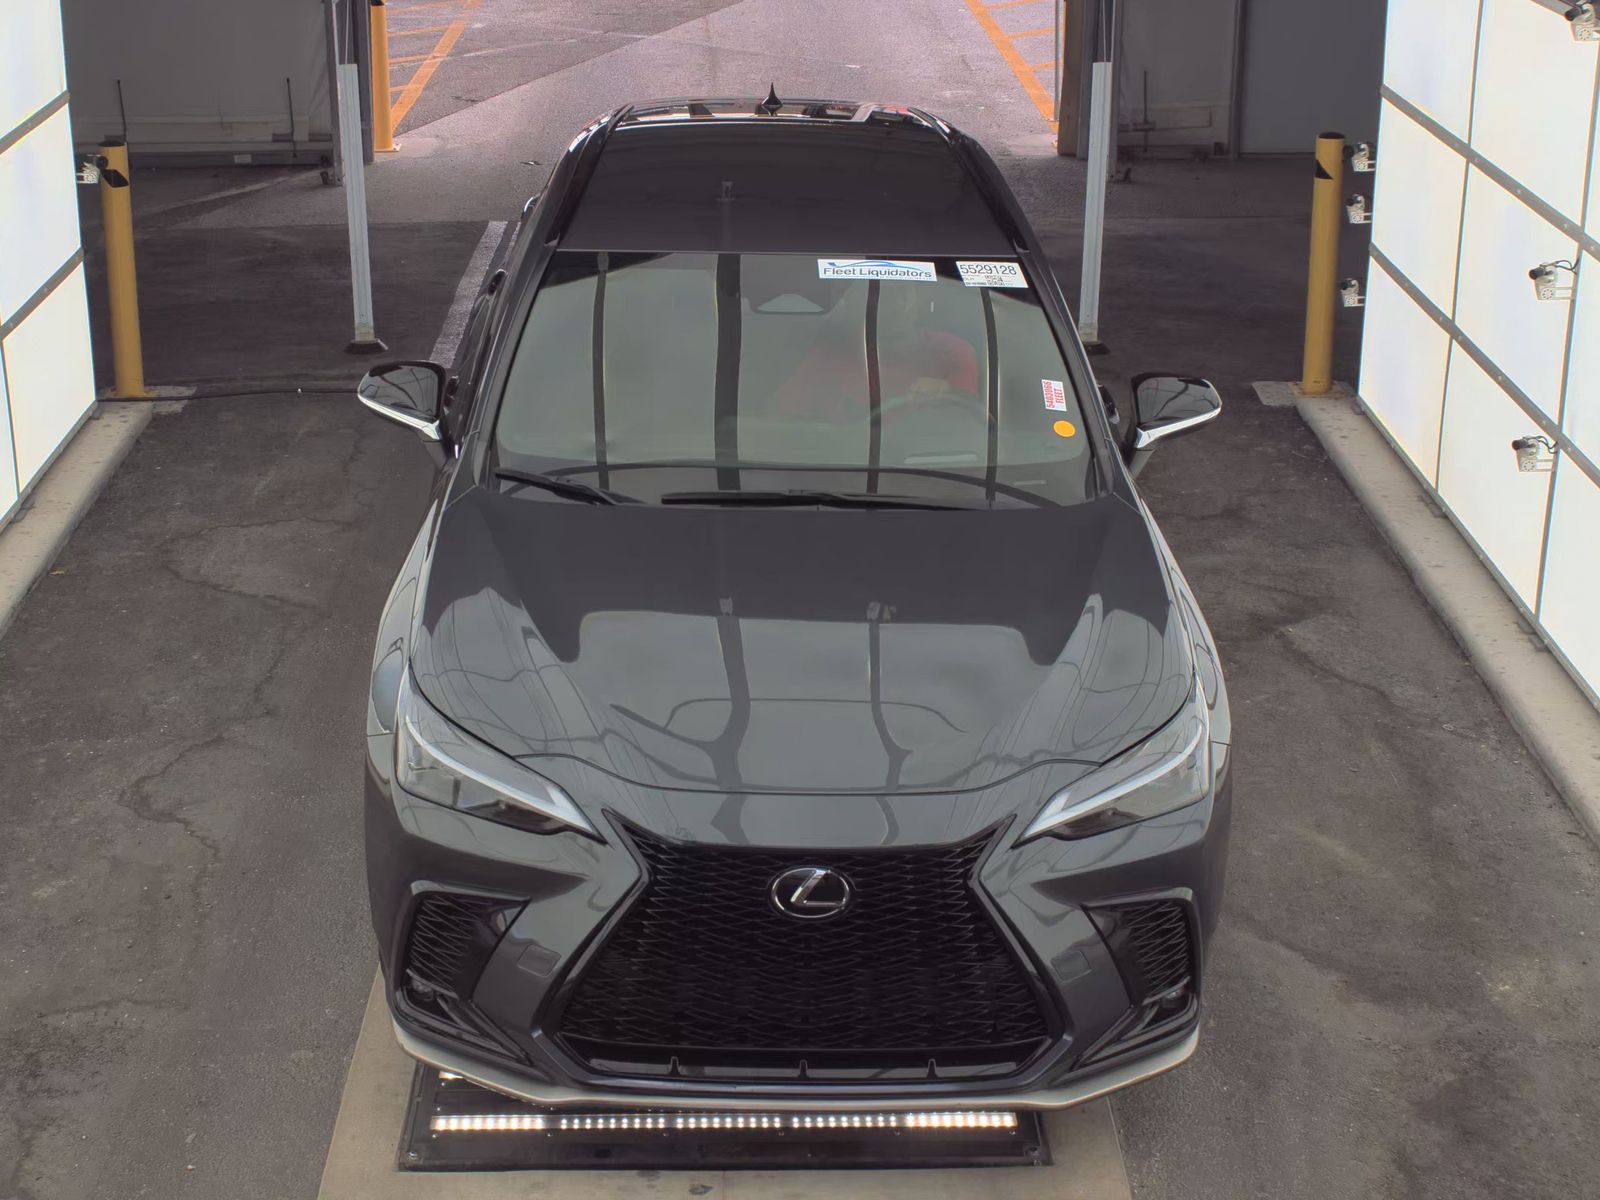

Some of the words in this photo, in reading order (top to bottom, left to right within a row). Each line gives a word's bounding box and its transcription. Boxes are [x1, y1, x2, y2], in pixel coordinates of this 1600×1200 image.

[823, 267, 857, 276] Fleet
[859, 267, 933, 278] Liquidators
[960, 264, 1017, 276] 5529128
[1053, 388, 1064, 404] FLEET
